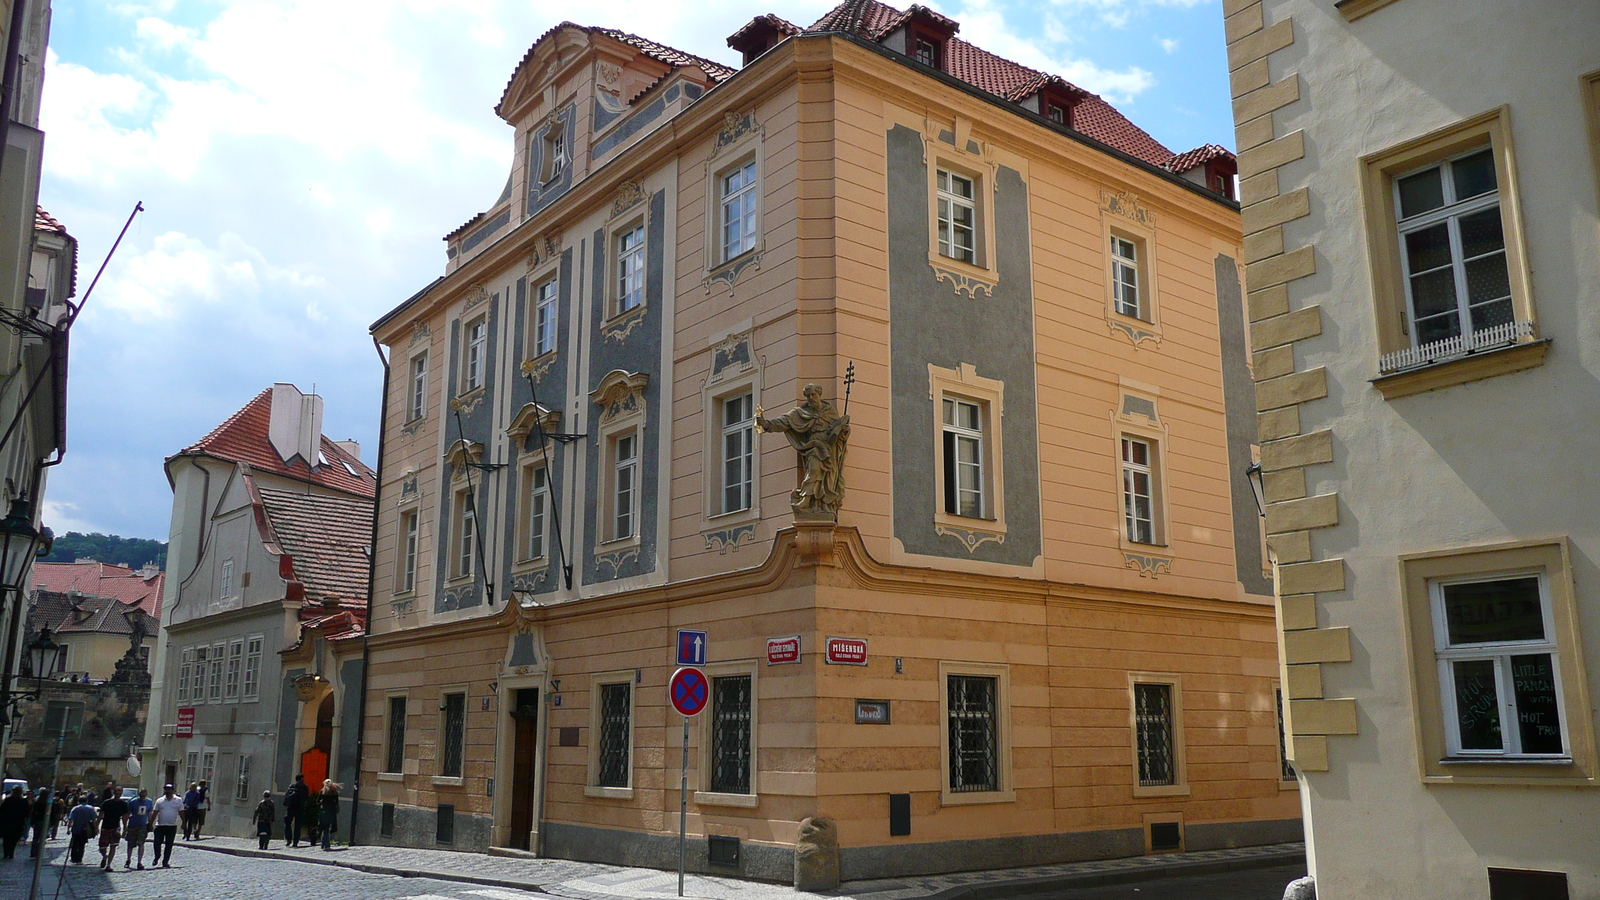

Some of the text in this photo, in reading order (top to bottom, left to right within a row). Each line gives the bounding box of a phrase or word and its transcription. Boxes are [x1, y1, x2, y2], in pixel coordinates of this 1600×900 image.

[832, 643, 864, 654] MÍŠENSKÁ
[1513, 664, 1546, 677] LITTLE
[1459, 672, 1484, 703] HOT
[1529, 696, 1553, 704] WITH
[1461, 686, 1497, 730] STRUDE
[1520, 712, 1545, 724] HOT
